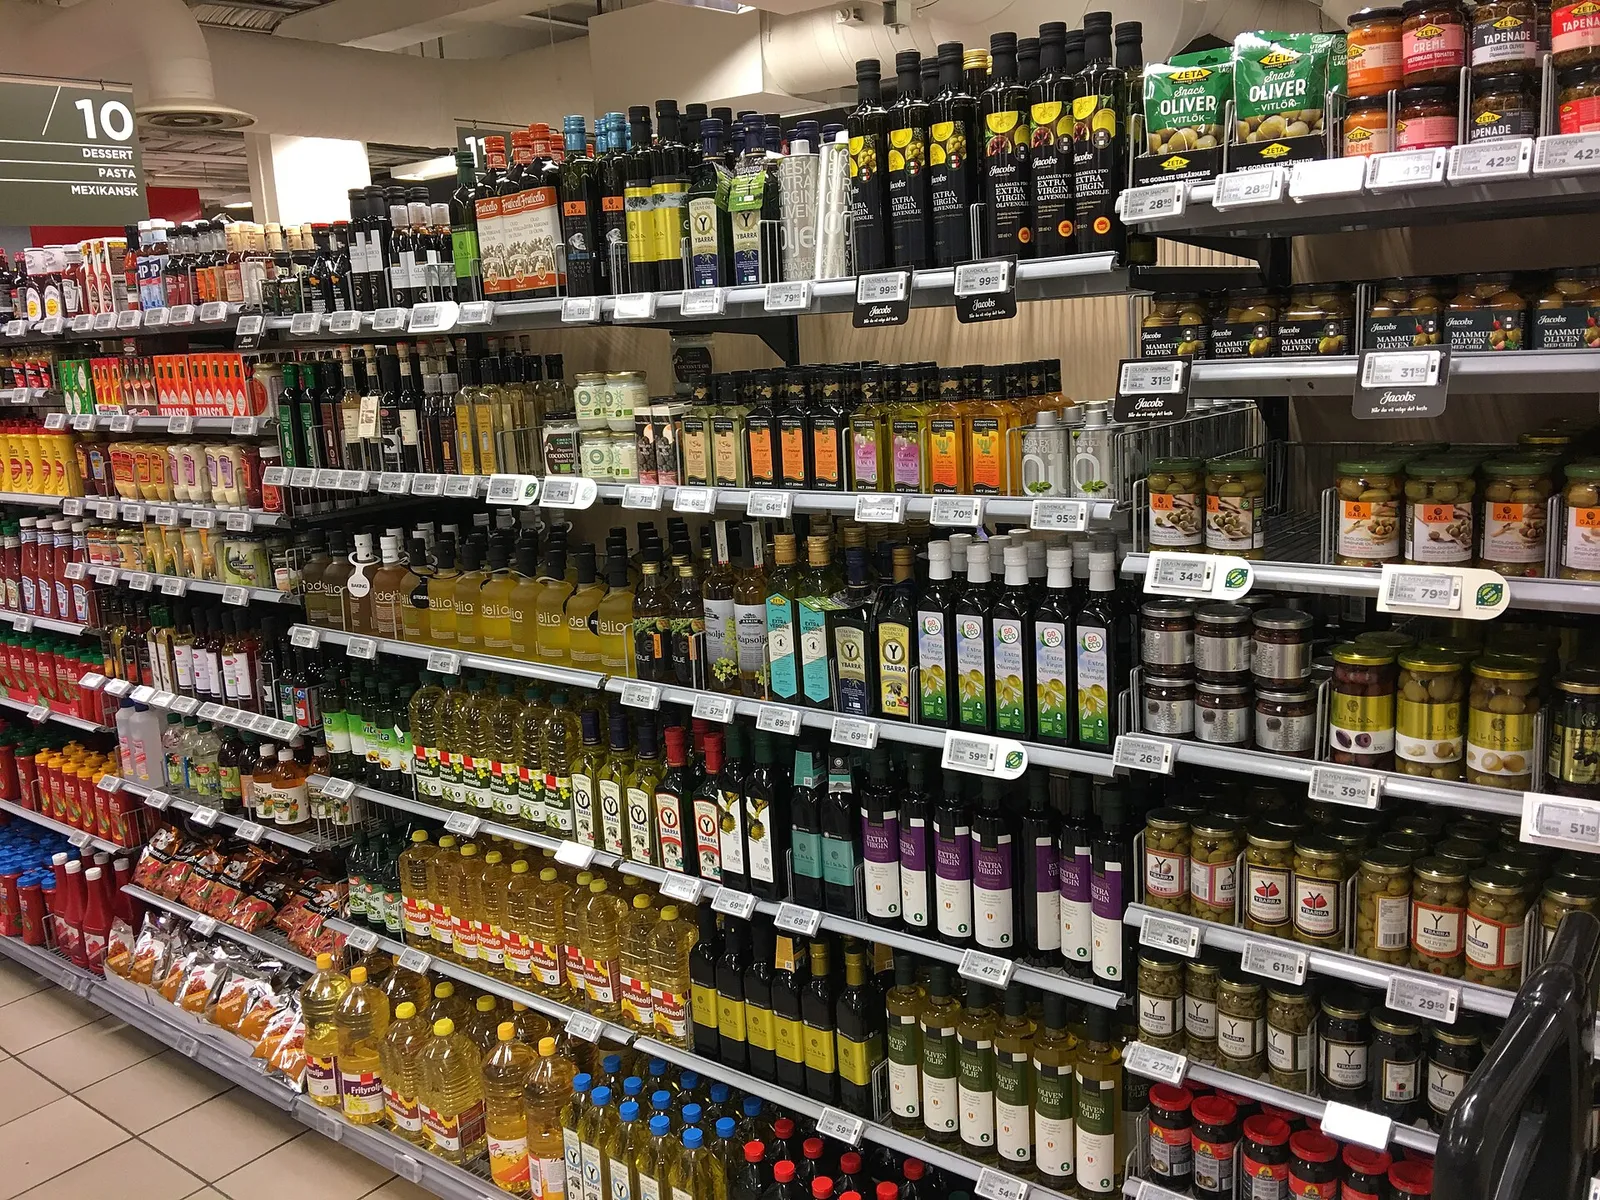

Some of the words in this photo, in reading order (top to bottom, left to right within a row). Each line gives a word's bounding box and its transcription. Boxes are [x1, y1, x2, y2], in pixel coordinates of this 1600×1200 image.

[1576, 5, 1597, 13] ZETA
[1498, 19, 1518, 27] ZETA
[1420, 28, 1438, 36] ZETA
[1484, 31, 1530, 45] TAPENADE
[1413, 40, 1446, 53] CREME
[1490, 44, 1507, 52] SVARTA
[1509, 43, 1524, 51] OLIVER
[1268, 52, 1295, 64] ZETA
[1177, 70, 1204, 79] ZETA
[1264, 69, 1296, 83] Snack
[1173, 86, 1205, 98] Snack
[1250, 79, 1306, 103] OLIVER
[1160, 96, 1216, 115] OLIVER
[75, 99, 134, 141] 10
[1172, 114, 1205, 124] VITLÖK
[1477, 115, 1496, 123] ZETA
[1266, 145, 1286, 154] ZETA
[1346, 143, 1373, 153] CREME
[82, 148, 133, 160] DESSERT
[1032, 156, 1058, 169] Jacobs
[1166, 158, 1184, 167] ZETA
[98, 167, 136, 179] PASTA
[989, 164, 1015, 177] Jacobs
[1076, 169, 1097, 177] KALAMATA
[1037, 179, 1066, 188] EXTRA
[1076, 175, 1101, 184] EXTRA
[71, 184, 139, 197] MEXIKANSK
[996, 187, 1024, 195] EXTRA
[1037, 186, 1068, 195] VIRGIN
[1076, 182, 1104, 192] VIRGIN
[933, 191, 956, 199] EXTRA
[996, 194, 1026, 202] VIRGIN
[1037, 193, 1072, 201] OLIVENOLJE
[1076, 189, 1110, 198] OLIVENOLJE
[933, 197, 958, 206] VIRGIN
[892, 202, 917, 211] VIRGIN
[933, 203, 963, 212] OLIVENOLJE
[973, 298, 995, 311] Jacobs
[869, 305, 891, 317] Jacobs
[1446, 317, 1473, 327] Jacobs
[1538, 315, 1567, 324] Jacobs
[1278, 326, 1300, 335] Jacobs
[1370, 322, 1397, 333] Jacobs
[1544, 328, 1589, 336] MAMMUT
[1211, 329, 1232, 338] Jacobs
[1452, 330, 1493, 338] MAMMUT
[1281, 338, 1320, 346] MAMMUT
[1377, 335, 1416, 343] MAMMUT
[1215, 340, 1250, 348] MAMMUT
[1380, 391, 1416, 405] Jacobs
[1135, 398, 1164, 410] Jacobs
[738, 635, 768, 644] Rapsolje
[927, 641, 942, 649] Extra
[1087, 641, 1100, 649] ECO
[889, 645, 898, 659] Y
[927, 648, 943, 656] Virgin
[921, 654, 943, 662] Olivenolje
[959, 658, 982, 667] Olivenolje
[841, 662, 861, 670] YBARRA
[883, 665, 906, 673] YBARRA
[996, 664, 1020, 672] Olivenolje
[1087, 666, 1105, 675] Virgin
[1038, 667, 1064, 676] Olivenolje
[1079, 672, 1105, 681] Olivenolje
[576, 809, 591, 817] YBARRA
[604, 816, 619, 824] YBARRA
[631, 825, 648, 833] YBARRA
[661, 827, 679, 835] YBARRA
[699, 835, 717, 844] YBARRA
[866, 841, 889, 849] VIRGIN
[937, 850, 959, 860] EXTRA
[938, 857, 960, 866] VIRGIN
[978, 860, 1002, 870] EXTRA
[978, 866, 1002, 876] VIRGIN
[1254, 896, 1281, 904] YBARRA
[405, 908, 426, 919] Rapsolje
[1301, 906, 1328, 916] YBARRA
[1424, 929, 1450, 937] YBARRA
[477, 933, 500, 946] Rapsolje
[505, 943, 530, 957] Rapsolje
[889, 1041, 903, 1052] OLJE
[924, 1048, 947, 1060] OLIVEN
[926, 1056, 944, 1066] OLJE
[960, 1060, 983, 1073] OLIVEN
[963, 1068, 980, 1079] OLJE
[998, 1080, 1015, 1092] OLJE
[1038, 1087, 1064, 1100] OLIVEN
[1041, 1095, 1060, 1106] OLJE
[1079, 1101, 1105, 1115] OLIVEN
[1082, 1109, 1101, 1121] OLJE
